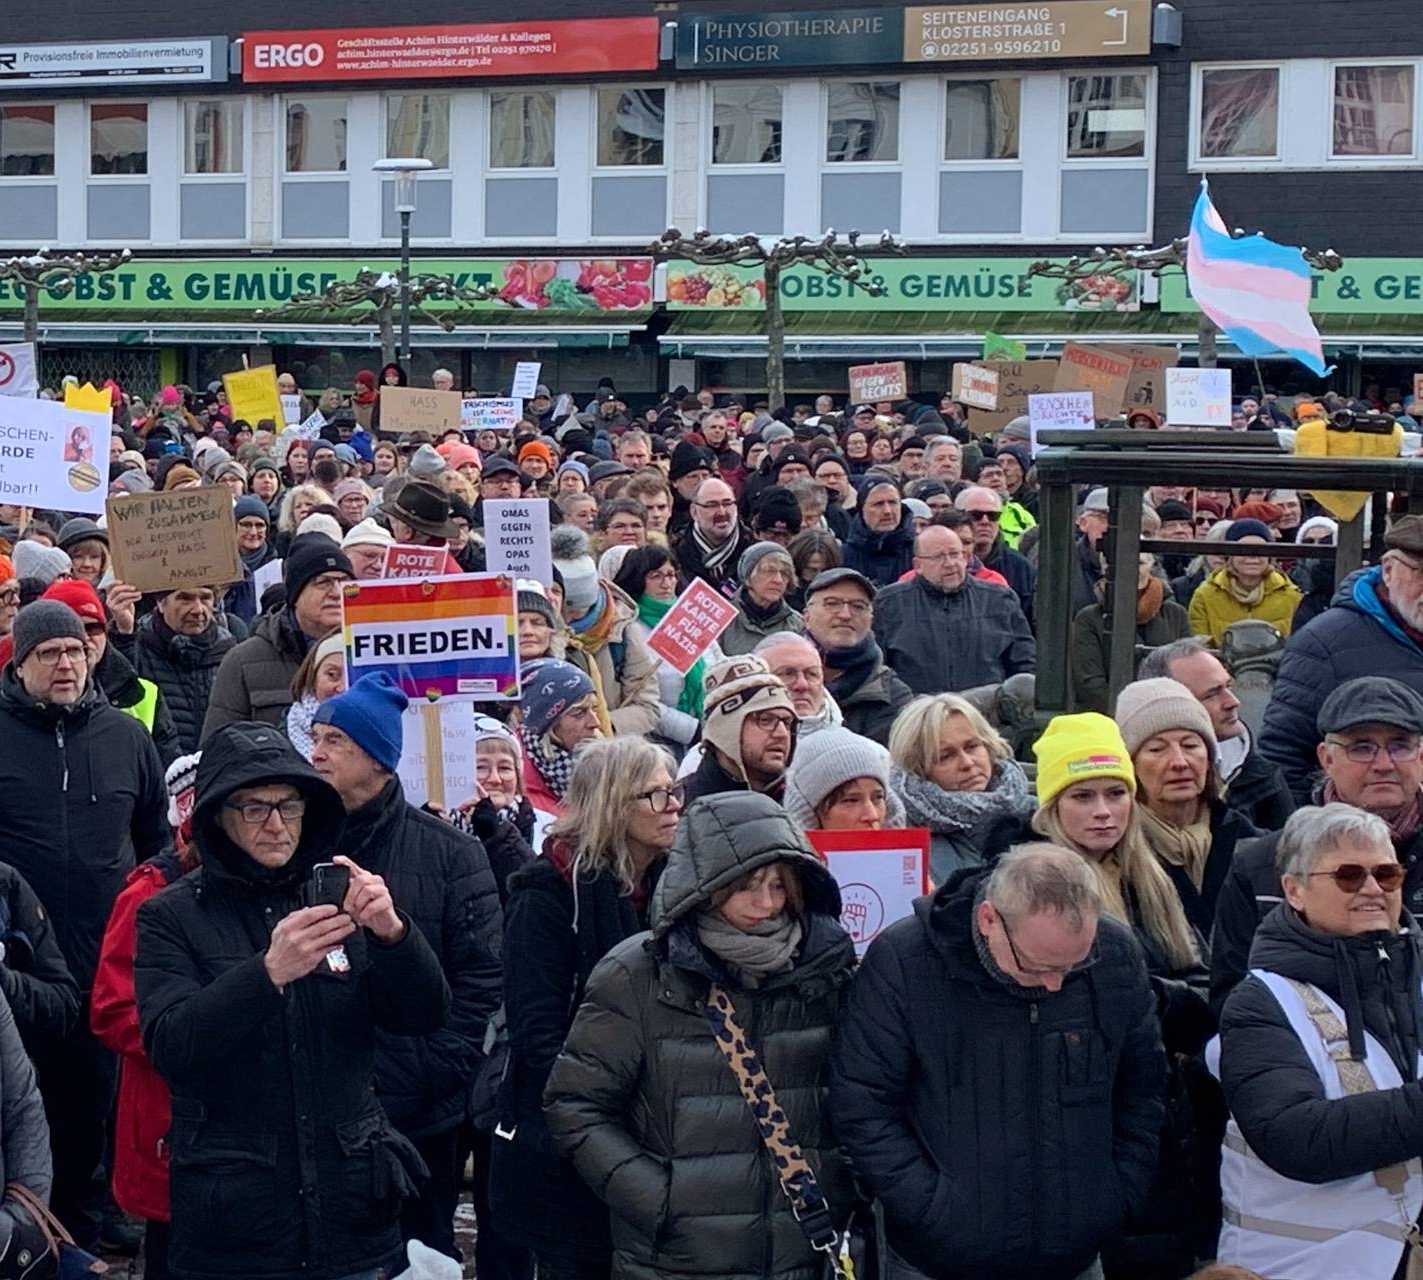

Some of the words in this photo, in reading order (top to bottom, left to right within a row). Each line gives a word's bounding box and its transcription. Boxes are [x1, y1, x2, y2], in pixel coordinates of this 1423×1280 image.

[922, 9, 1050, 25] SEITENEINGANG
[706, 17, 884, 39] PHYSIOTHERAPIE
[923, 24, 1054, 40] KLOSTERSTRAßE
[1059, 22, 1066, 35] 1
[337, 36, 403, 48] Geschäftsstelle
[405, 36, 436, 46] Achim
[437, 34, 499, 45] Hinterwälder
[510, 32, 551, 43] Kollegen
[941, 40, 1061, 57] 02251-9596210
[23, 50, 94, 63] Provisionsfreie
[96, 48, 204, 60] Immobilienvermietung
[254, 43, 324, 68] ERGO
[477, 45, 490, 54] Tel
[705, 44, 780, 62] SINGER
[336, 57, 492, 70] www.achim-hinterwaelder.ergo.de
[46, 273, 137, 300] OBST
[146, 273, 174, 300] &
[184, 266, 337, 301] GEMÜSE
[781, 275, 858, 298] OBST
[900, 267, 1033, 298] GEMÜSE
[1337, 275, 1362, 299] &
[854, 375, 885, 388] GEGEN
[861, 383, 902, 400] RECHTS
[460, 417, 515, 426] ALTERNATIV
[113, 502, 144, 521] WIR
[150, 496, 211, 515] HALTEN
[501, 509, 530, 518] OMAS
[146, 506, 222, 530] ZUSAMMEN
[500, 522, 531, 532] GEGEN
[499, 536, 534, 545] RECHTS
[396, 553, 434, 567] ROTE
[505, 550, 530, 559] OPAS
[506, 563, 530, 573] Auch
[694, 591, 726, 619] ROTE
[681, 599, 721, 633] KARTE
[678, 617, 703, 639] FÜR
[353, 626, 505, 659] FRIEDEN.
[663, 624, 699, 655] NAZIS
